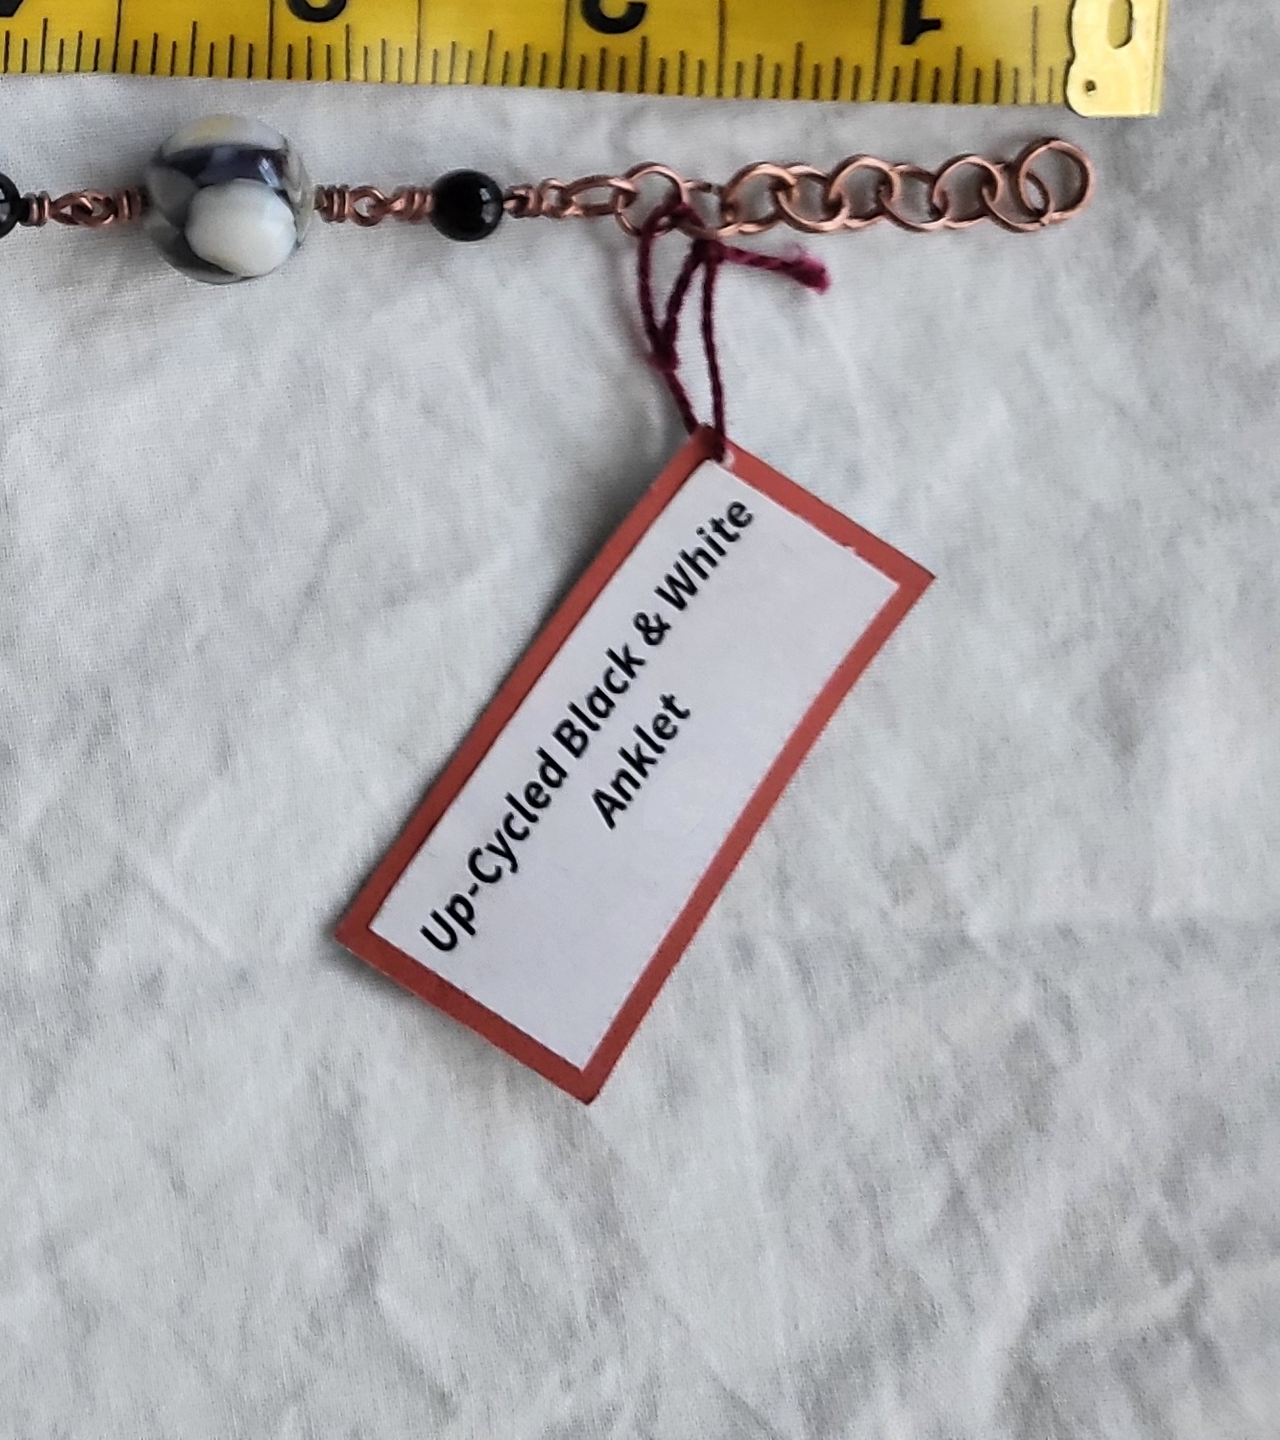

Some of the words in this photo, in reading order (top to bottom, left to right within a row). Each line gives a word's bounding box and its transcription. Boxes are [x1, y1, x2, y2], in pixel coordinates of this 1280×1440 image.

[418, 746, 568, 953] Up-Cycled
[551, 643, 646, 760] Black
[632, 610, 672, 647] &
[654, 500, 754, 613] White
[591, 693, 691, 830] Anklet
